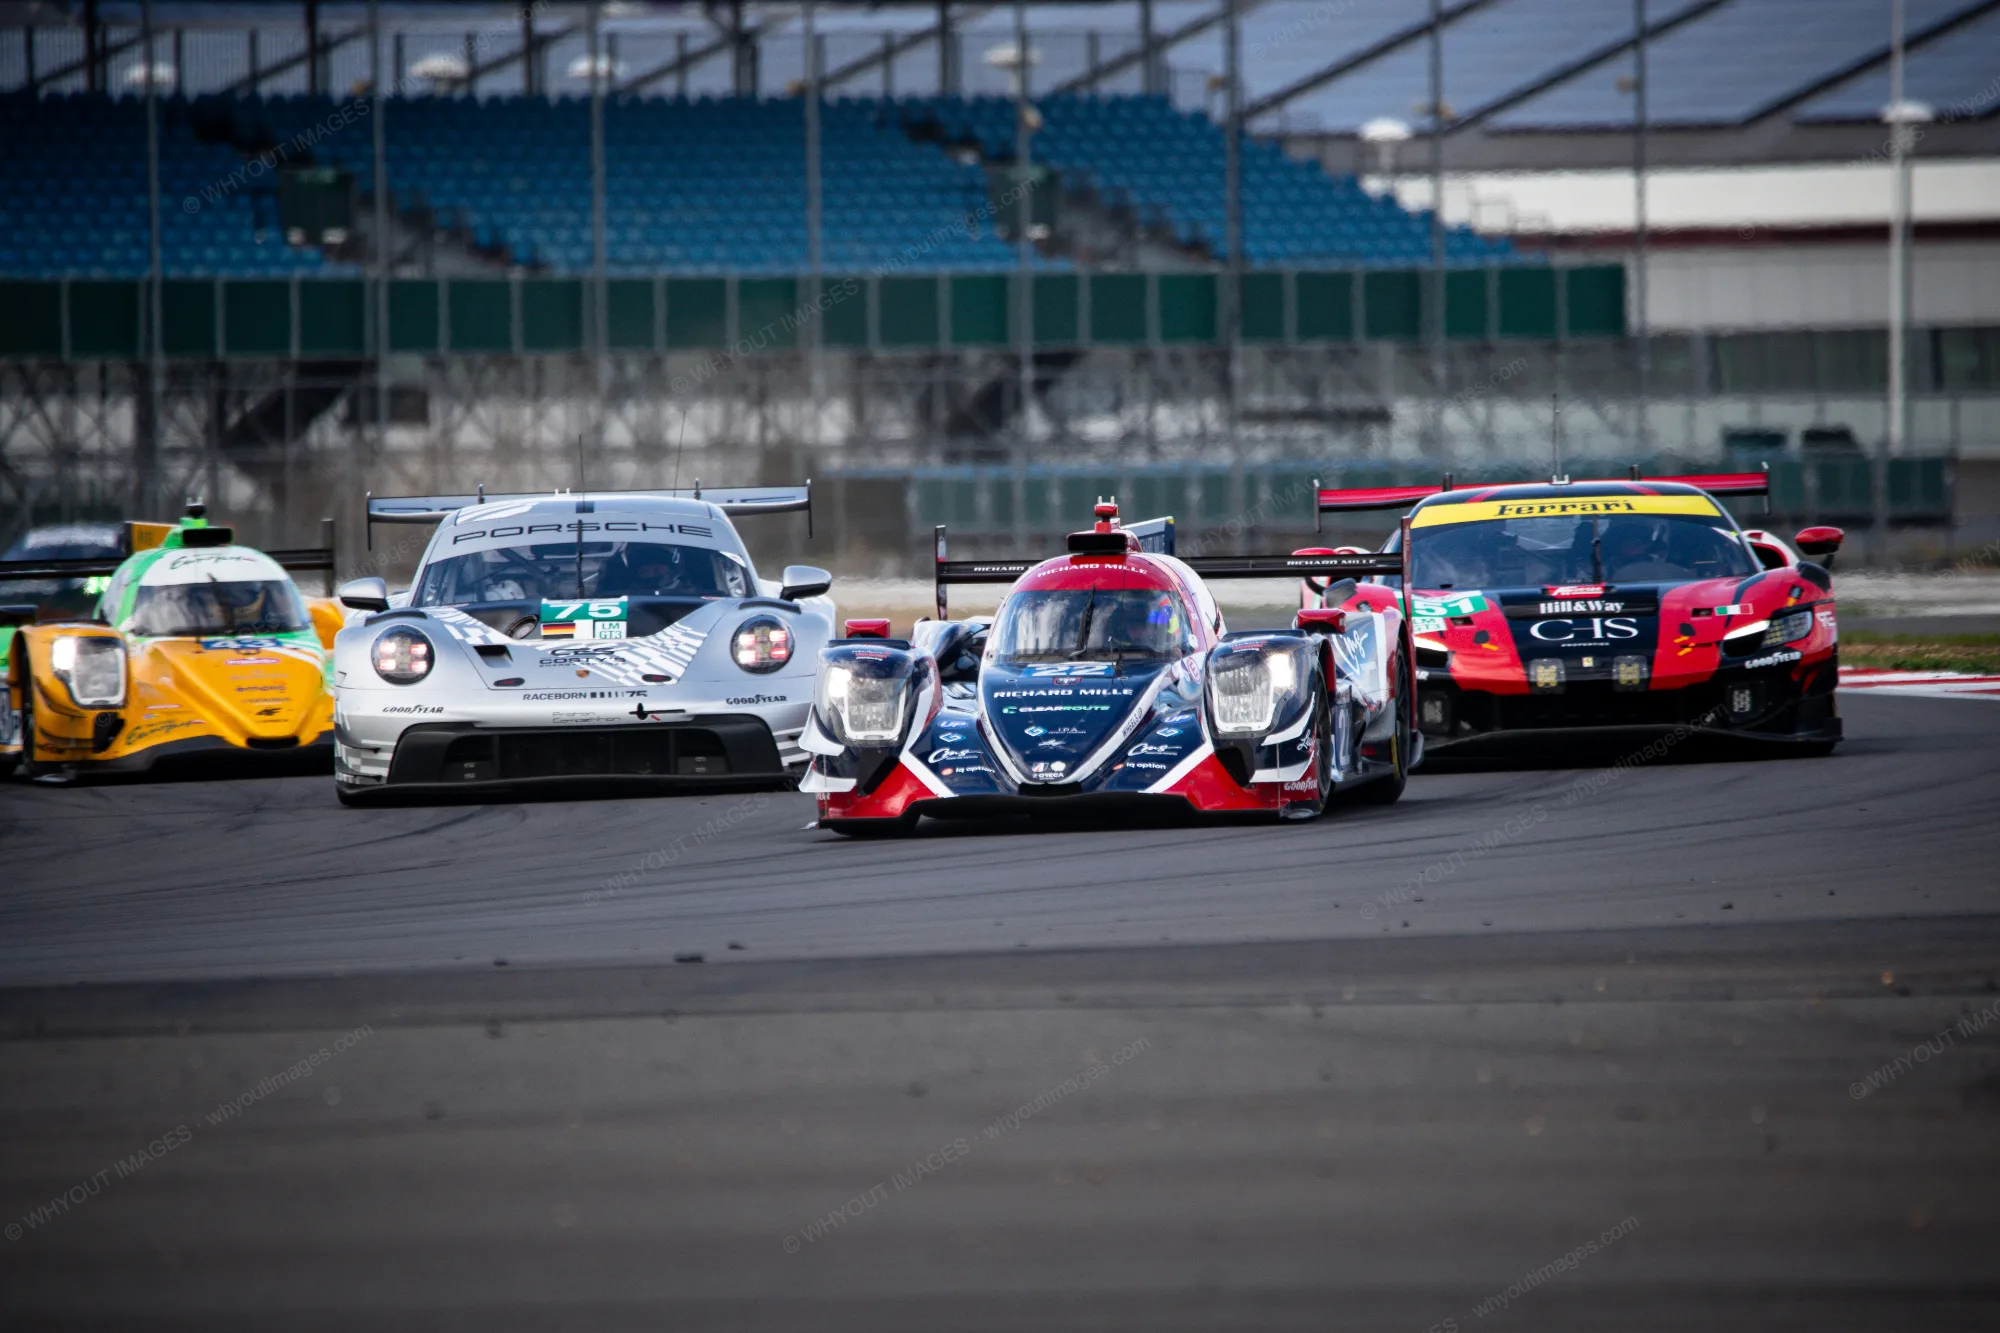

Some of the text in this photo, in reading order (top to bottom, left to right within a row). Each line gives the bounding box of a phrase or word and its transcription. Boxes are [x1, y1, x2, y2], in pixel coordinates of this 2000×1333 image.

[1494, 500, 1636, 516] Ferrari
[452, 522, 713, 545] PORSCHE
[1037, 563, 1100, 578] RICHARD
[1104, 563, 1148, 575] MILLE
[549, 602, 622, 620] 75
[1413, 598, 1475, 617] 51
[1539, 600, 1625, 615] Hill&Way
[600, 631, 622, 640] GT3
[1744, 652, 1802, 669] GOODYEAR
[1031, 665, 1109, 677] 22
[522, 692, 587, 701] RACEBORN
[993, 688, 1134, 699] RICHARD MILLE
[726, 694, 788, 705] GOODYEAR
[382, 704, 445, 715] GOODYEAR
[1019, 705, 1111, 713] CLEARROUTE
[940, 720, 967, 728] UP
[1164, 714, 1190, 723] UP
[966, 765, 996, 774] option
[1136, 762, 1167, 770] option
